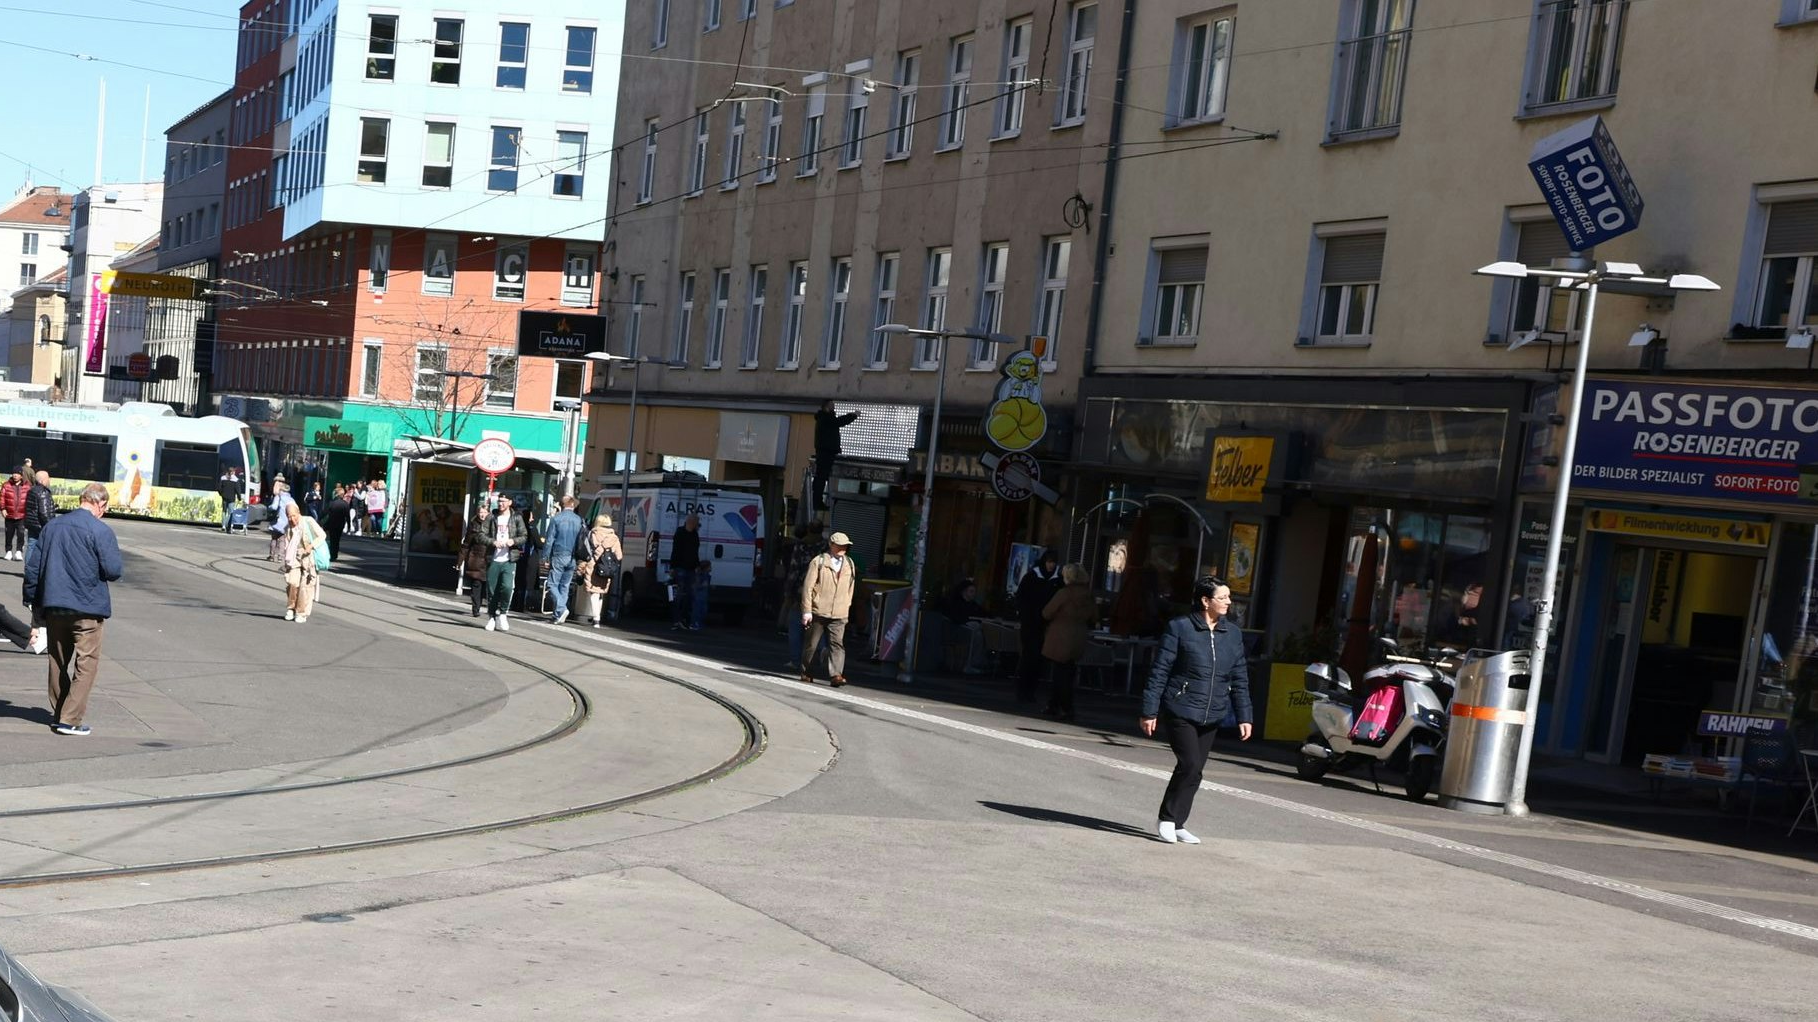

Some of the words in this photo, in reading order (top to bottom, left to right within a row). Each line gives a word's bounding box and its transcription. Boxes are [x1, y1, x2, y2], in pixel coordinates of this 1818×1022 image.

[1554, 164, 1597, 234] ROSENBERGER
[1566, 146, 1625, 231] FOTO
[1536, 164, 1584, 246] SOFORT-FOTO-SERVICE
[125, 279, 186, 292] NEUROTH
[543, 336, 581, 346] ADANA
[1591, 389, 1818, 434] PASSFOTO
[1633, 431, 1801, 460] ROSENBERGER
[1216, 445, 1262, 490] Felber
[1574, 464, 1596, 477] DER
[1598, 466, 1638, 481] BILDER
[1641, 468, 1705, 485] SPEZIALIST
[1714, 475, 1800, 493] SOFORT-FOTO
[996, 472, 1027, 498] TRAFIK
[1624, 515, 1720, 538] Filmentwicklung
[1288, 689, 1315, 708] Felbe
[1707, 714, 1775, 734] RAHMEN
